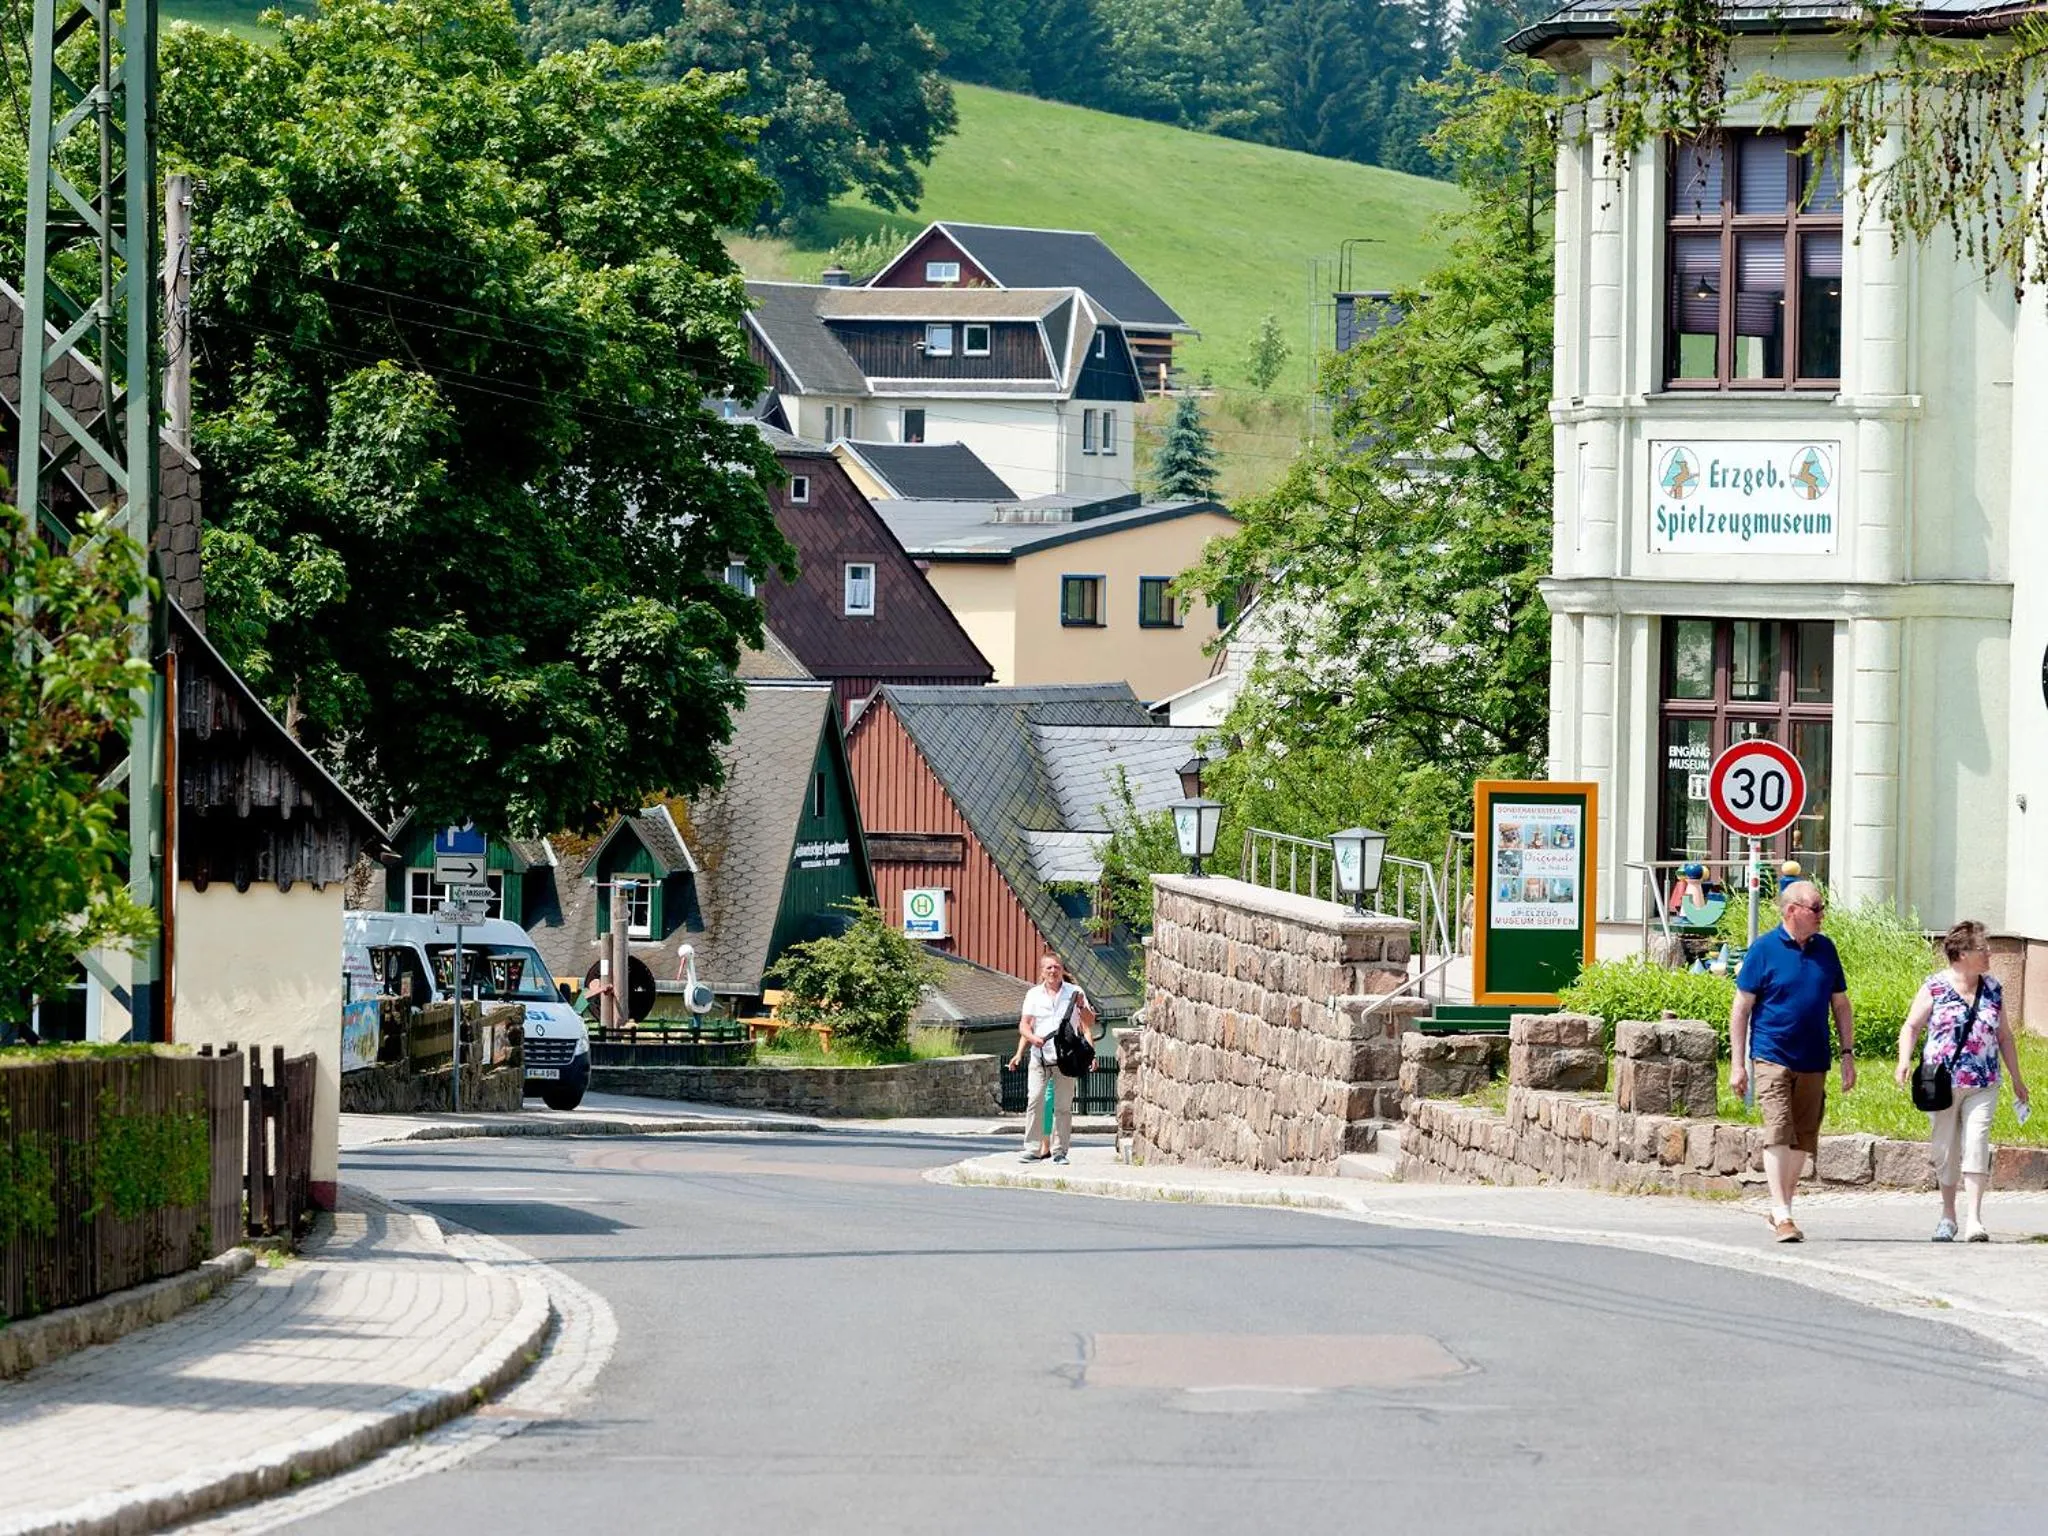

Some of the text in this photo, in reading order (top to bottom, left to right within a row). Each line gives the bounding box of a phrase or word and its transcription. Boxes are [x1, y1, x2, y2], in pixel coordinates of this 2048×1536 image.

[1709, 458, 1785, 496] Erzgeb.
[1656, 504, 1832, 542] Spielzeugmuseum
[1668, 745, 1711, 758] EINGANG
[1668, 759, 1710, 770] MUSEUM
[1730, 768, 1785, 812] 30
[1494, 916, 1535, 926] MUSEUM
